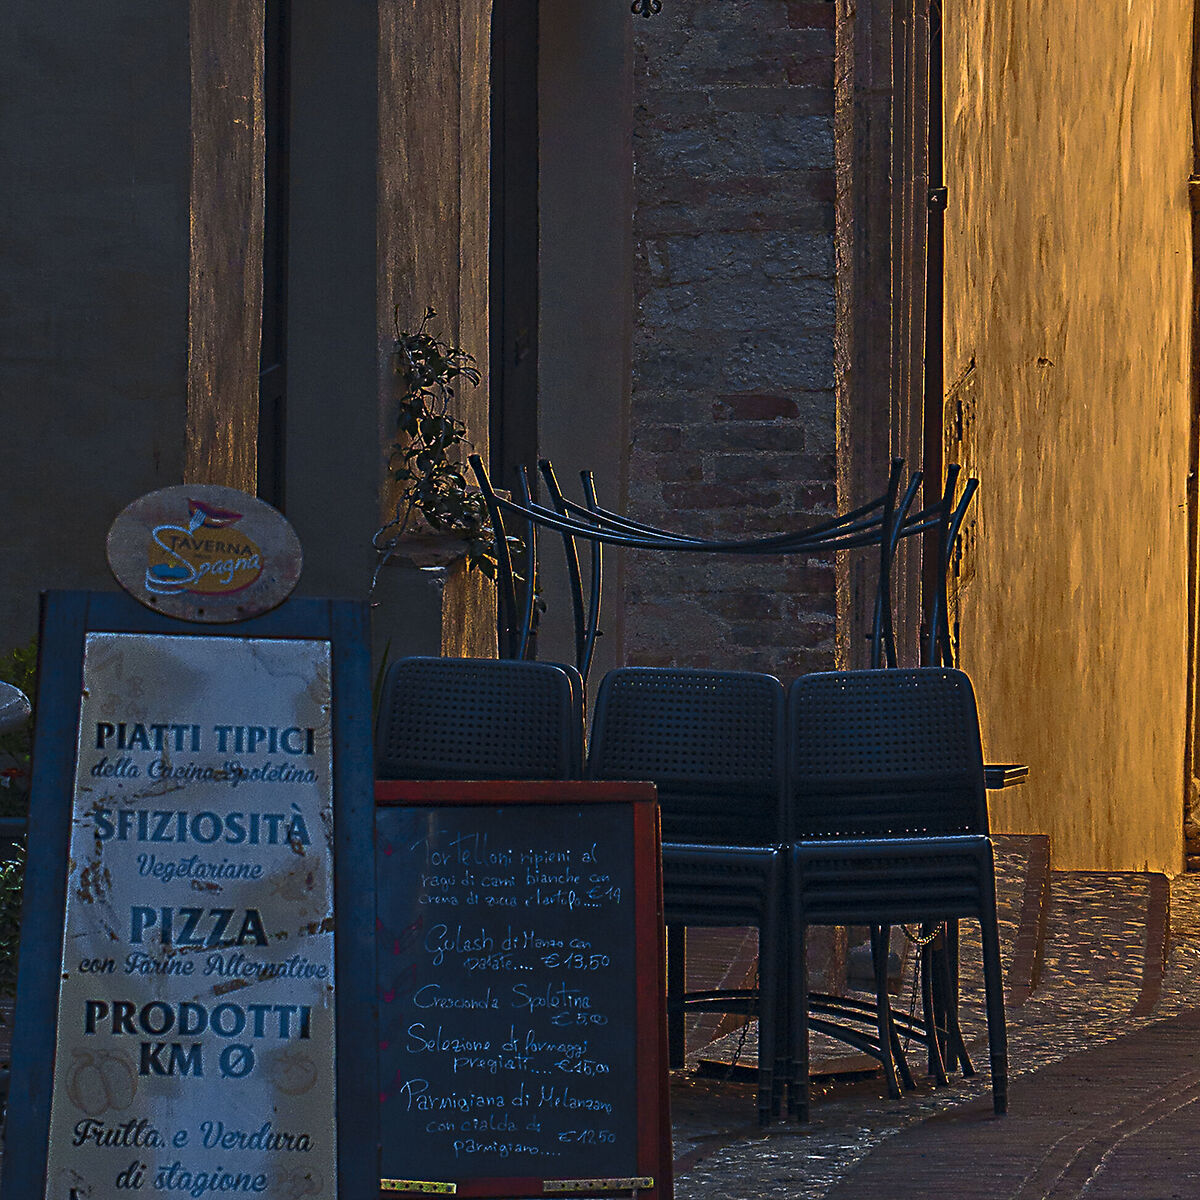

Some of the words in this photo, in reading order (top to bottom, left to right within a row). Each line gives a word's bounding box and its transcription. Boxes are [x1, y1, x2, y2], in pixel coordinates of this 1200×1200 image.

[145, 524, 261, 595] Spagna
[171, 535, 253, 556] TAVERNA
[96, 722, 201, 753] PIATTI
[214, 725, 316, 756] TIPICI
[90, 756, 141, 779] della
[93, 803, 312, 846] SFIZIOSITÀ
[137, 853, 265, 881] Vegetariane
[409, 831, 513, 866] Tortelloni
[520, 849, 571, 869] ripieni
[582, 842, 597, 864] al
[461, 871, 476, 887] di
[526, 866, 581, 885] bianche
[589, 872, 611, 884] con
[130, 905, 269, 947] PIZZA
[425, 923, 494, 967] Gulash
[501, 925, 519, 950] di
[79, 957, 116, 975] con
[123, 952, 195, 977] Farine
[203, 954, 329, 982] Alternative
[84, 1000, 312, 1040] PRODOTTI
[501, 1025, 519, 1052] di
[138, 1043, 202, 1077] KM
[400, 1078, 506, 1112] Parmigiana
[511, 1082, 530, 1107] di
[172, 1129, 189, 1149] e
[200, 1120, 314, 1152] Verdura
[425, 1121, 456, 1134] con
[460, 1113, 519, 1133] cialda
[116, 1161, 146, 1190] di
[153, 1161, 269, 1198] stagione
